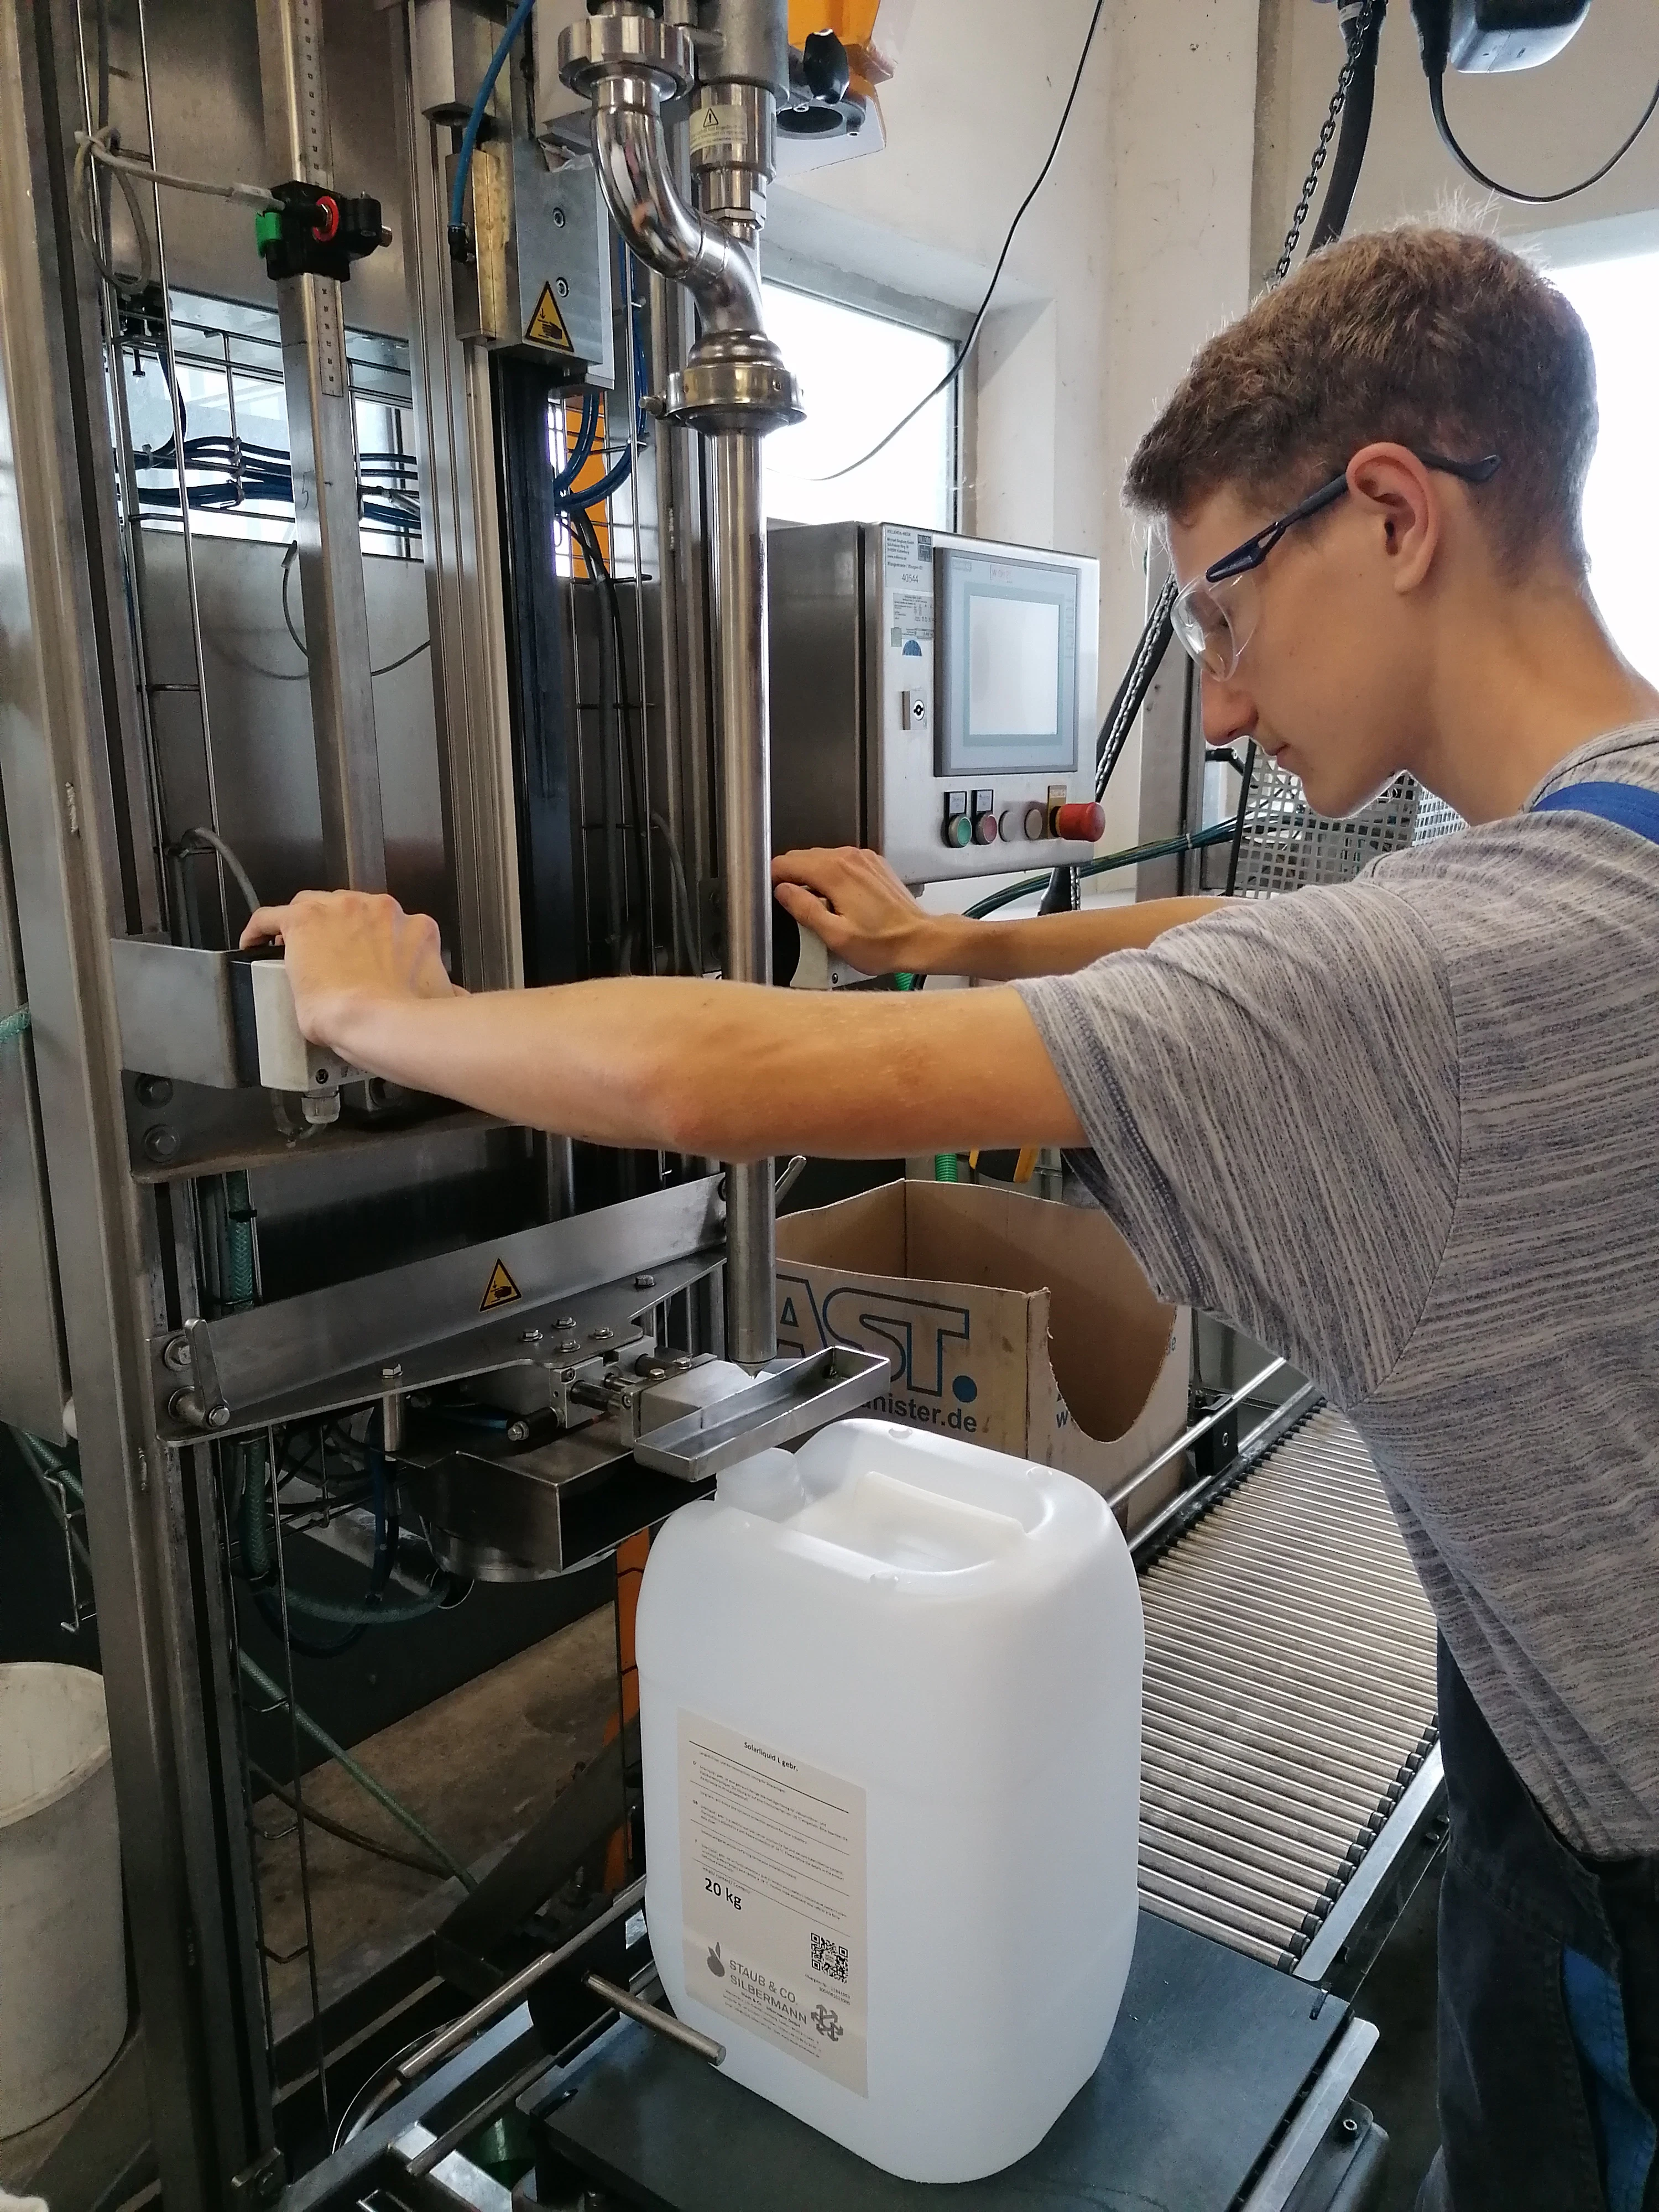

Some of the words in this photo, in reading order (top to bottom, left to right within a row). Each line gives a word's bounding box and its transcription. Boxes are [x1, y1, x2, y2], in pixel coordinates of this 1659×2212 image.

[901, 574, 919, 583] 40544
[861, 1394, 977, 1433] nister.de
[744, 1741, 776, 1761] Solarliquid
[782, 1760, 799, 1771] gebr.
[705, 1877, 721, 1896] 20
[726, 1887, 742, 1910] kg
[729, 1959, 765, 1986] STAUB
[769, 1981, 777, 1994] &
[731, 1975, 807, 2025] SILBERMANN
